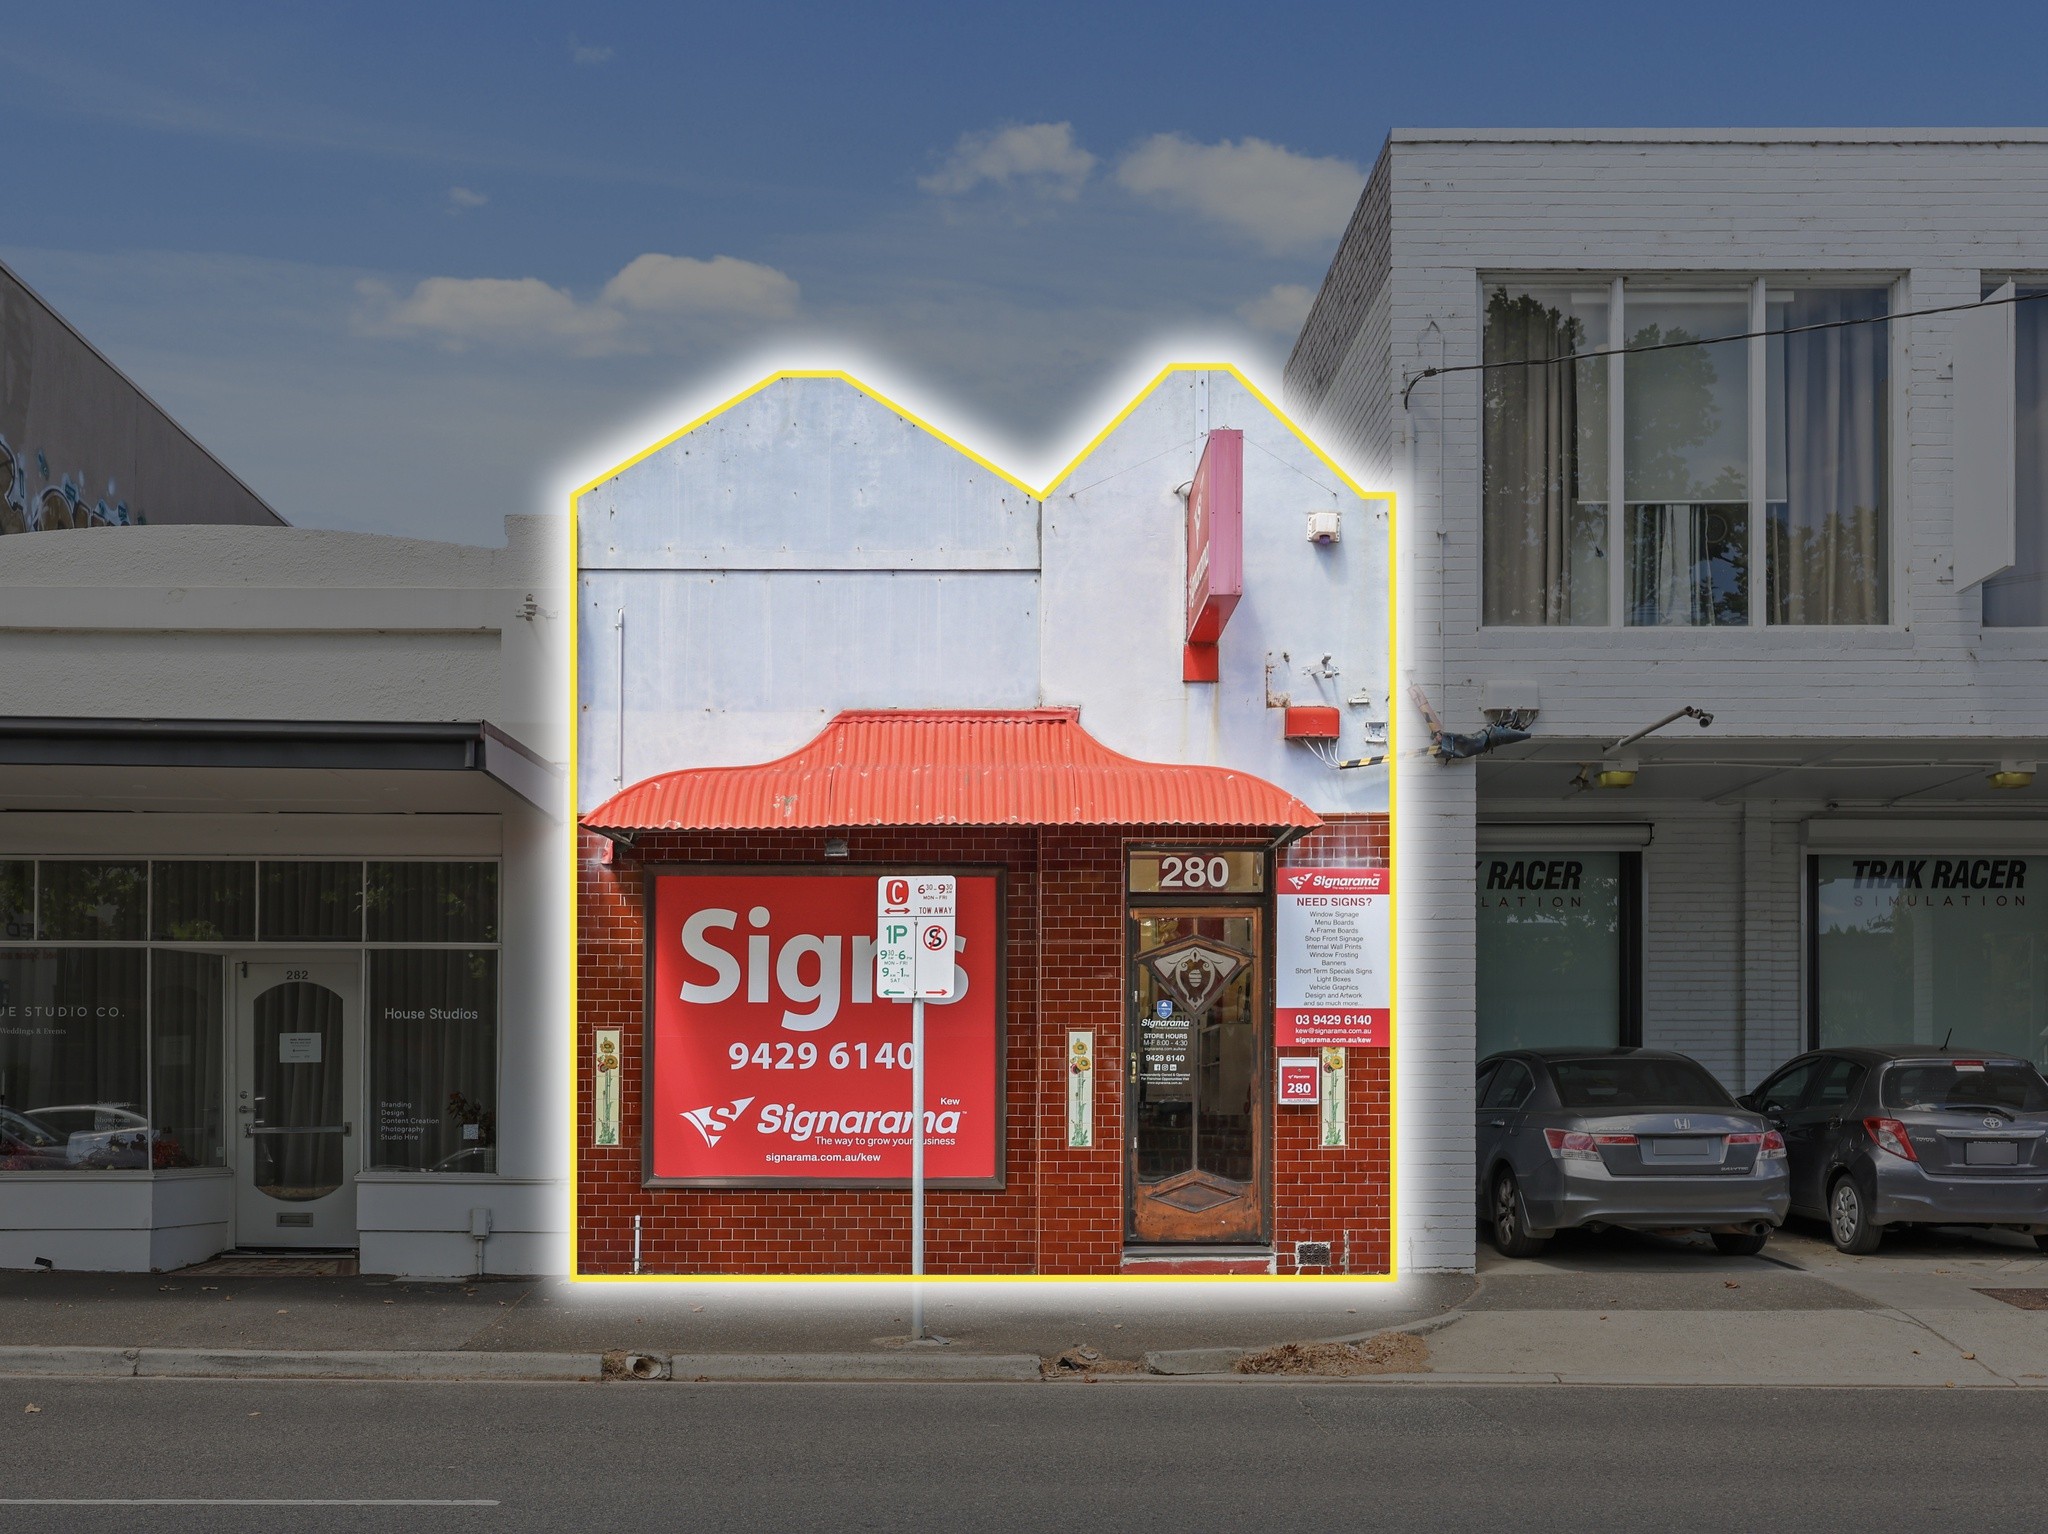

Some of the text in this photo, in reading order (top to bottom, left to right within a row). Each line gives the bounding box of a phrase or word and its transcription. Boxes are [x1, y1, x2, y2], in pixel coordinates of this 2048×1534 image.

[1161, 856, 1229, 888] 280
[1486, 860, 1583, 890] RACER
[1852, 860, 2027, 889] TRAK RACER
[1313, 875, 1380, 889] Signarama
[1296, 897, 1373, 907] NEED SIGNS?
[1853, 895, 2025, 907] SIMULATION
[919, 906, 953, 915] TOW AWAY
[1335, 911, 1360, 919] Signage
[886, 925, 908, 944] 1P
[286, 970, 309, 980] 282
[24, 1006, 88, 1017] STUDIO
[95, 1006, 125, 1017] CO.
[384, 1007, 479, 1020] House Studios
[1141, 1018, 1190, 1029] Signarama
[1295, 1014, 1372, 1025] 03 9429 6140
[43, 1027, 67, 1035] Events
[1295, 1027, 1372, 1036] kew@signarama.com.au
[1295, 1036, 1372, 1044] signarama.com.au/kew
[728, 1041, 914, 1070] 9429 6140
[1287, 1082, 1312, 1094] 280
[381, 1101, 412, 1109] Branding
[940, 1096, 960, 1106] Kew
[757, 1102, 961, 1142] Signarama
[380, 1126, 425, 1134] Photography
[815, 1136, 832, 1147] The
[834, 1138, 854, 1149] way
[855, 1137, 866, 1147] to
[867, 1138, 890, 1149] grow
[923, 1136, 956, 1147] usiness
[765, 1152, 881, 1163] signarama.com.au/kew
